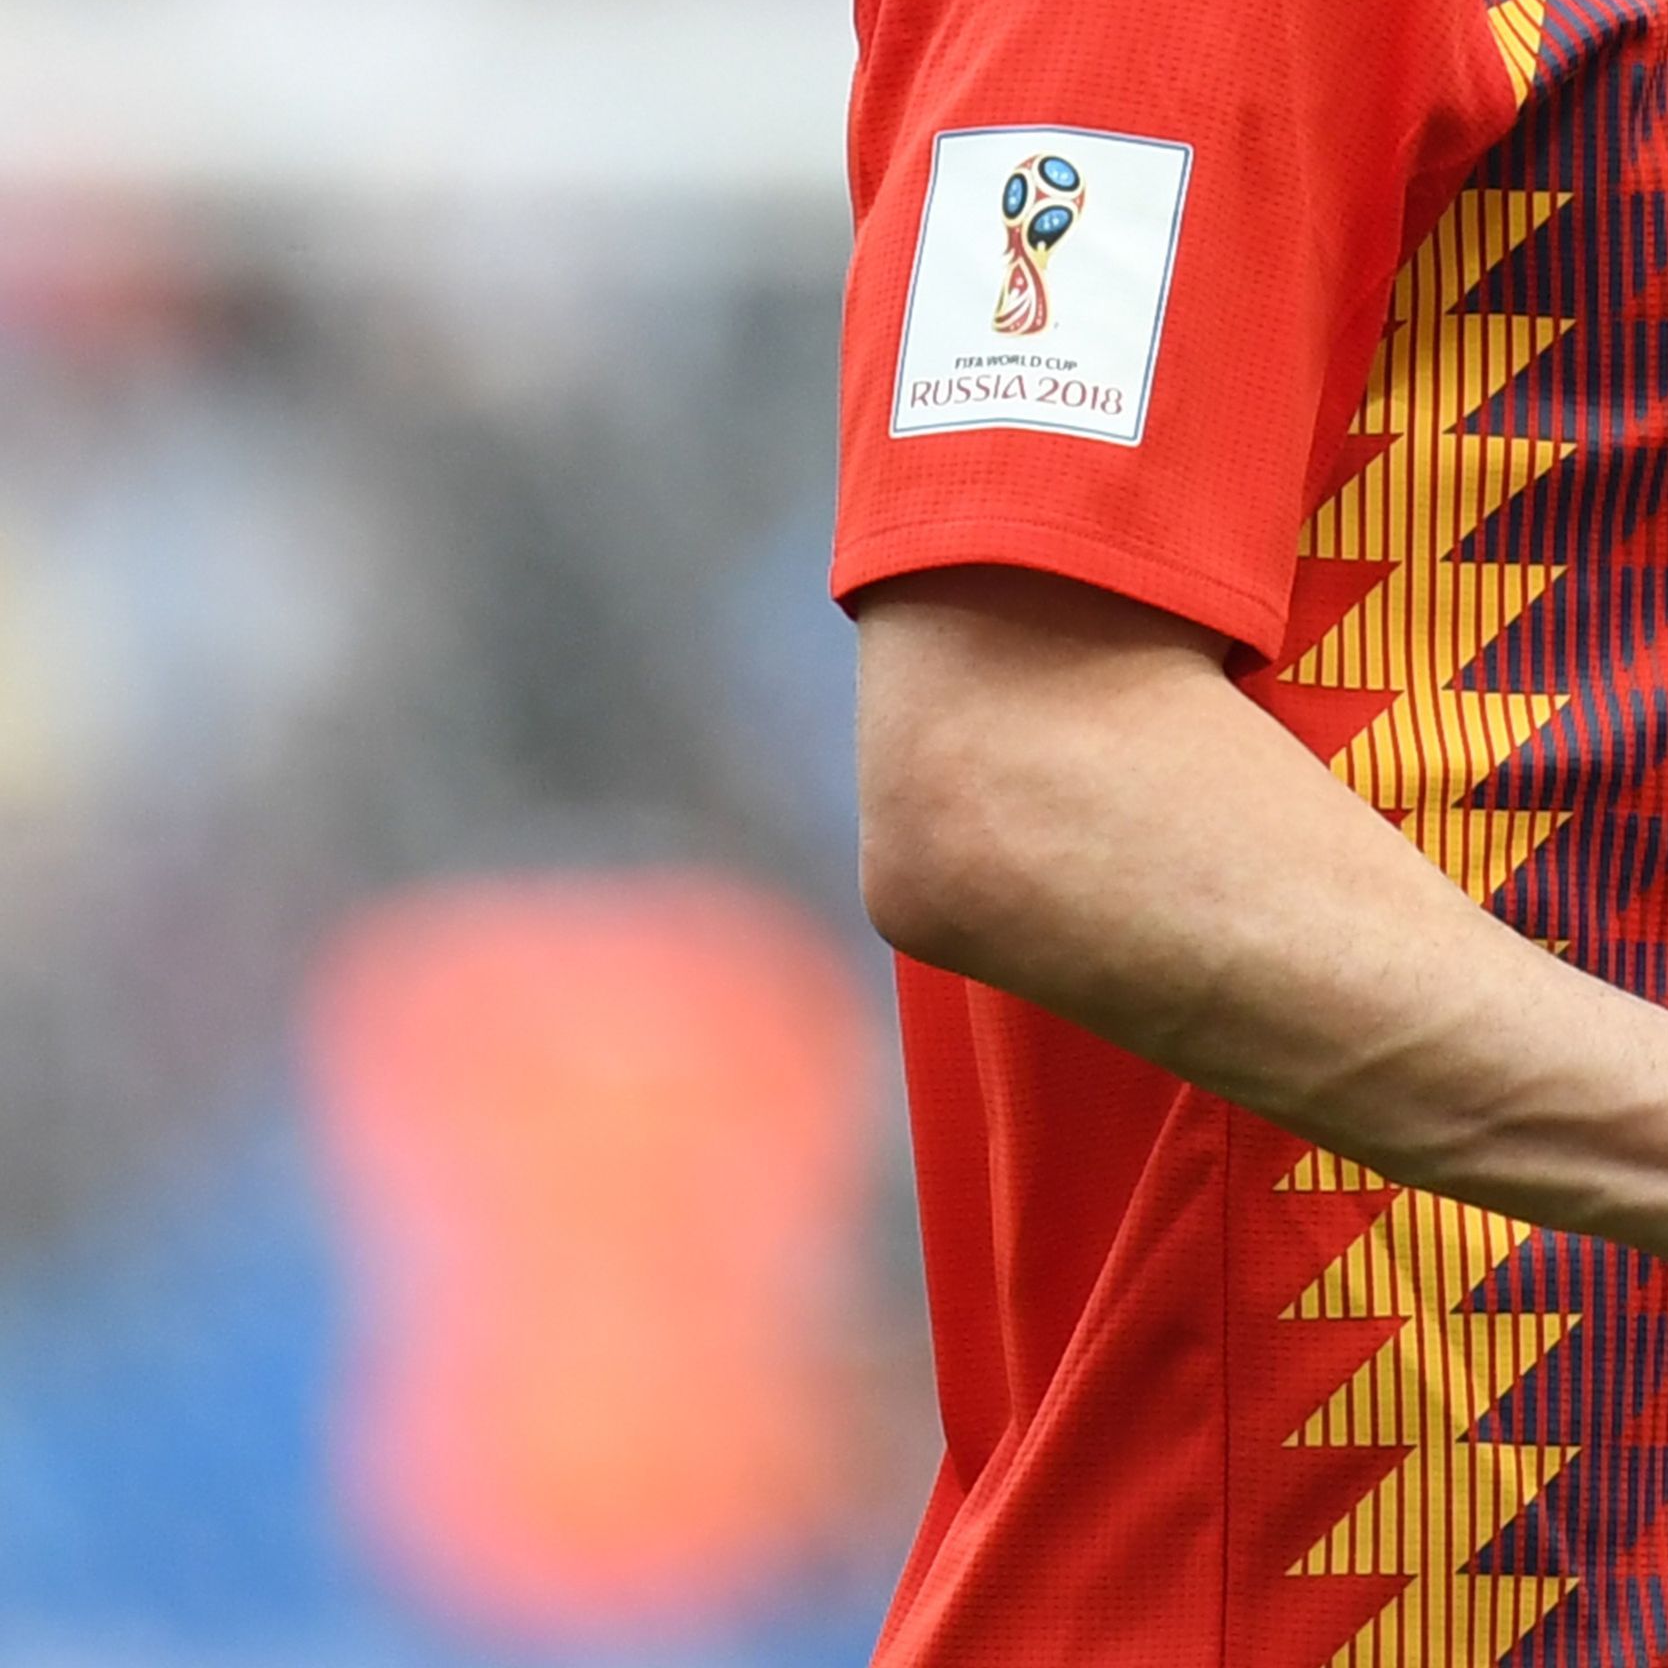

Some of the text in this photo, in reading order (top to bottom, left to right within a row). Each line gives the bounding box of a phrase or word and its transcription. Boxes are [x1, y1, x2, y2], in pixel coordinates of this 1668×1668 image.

[955, 354, 1078, 371] FIFA WORLD CUP
[910, 375, 1122, 415] RUSSIA 2018
